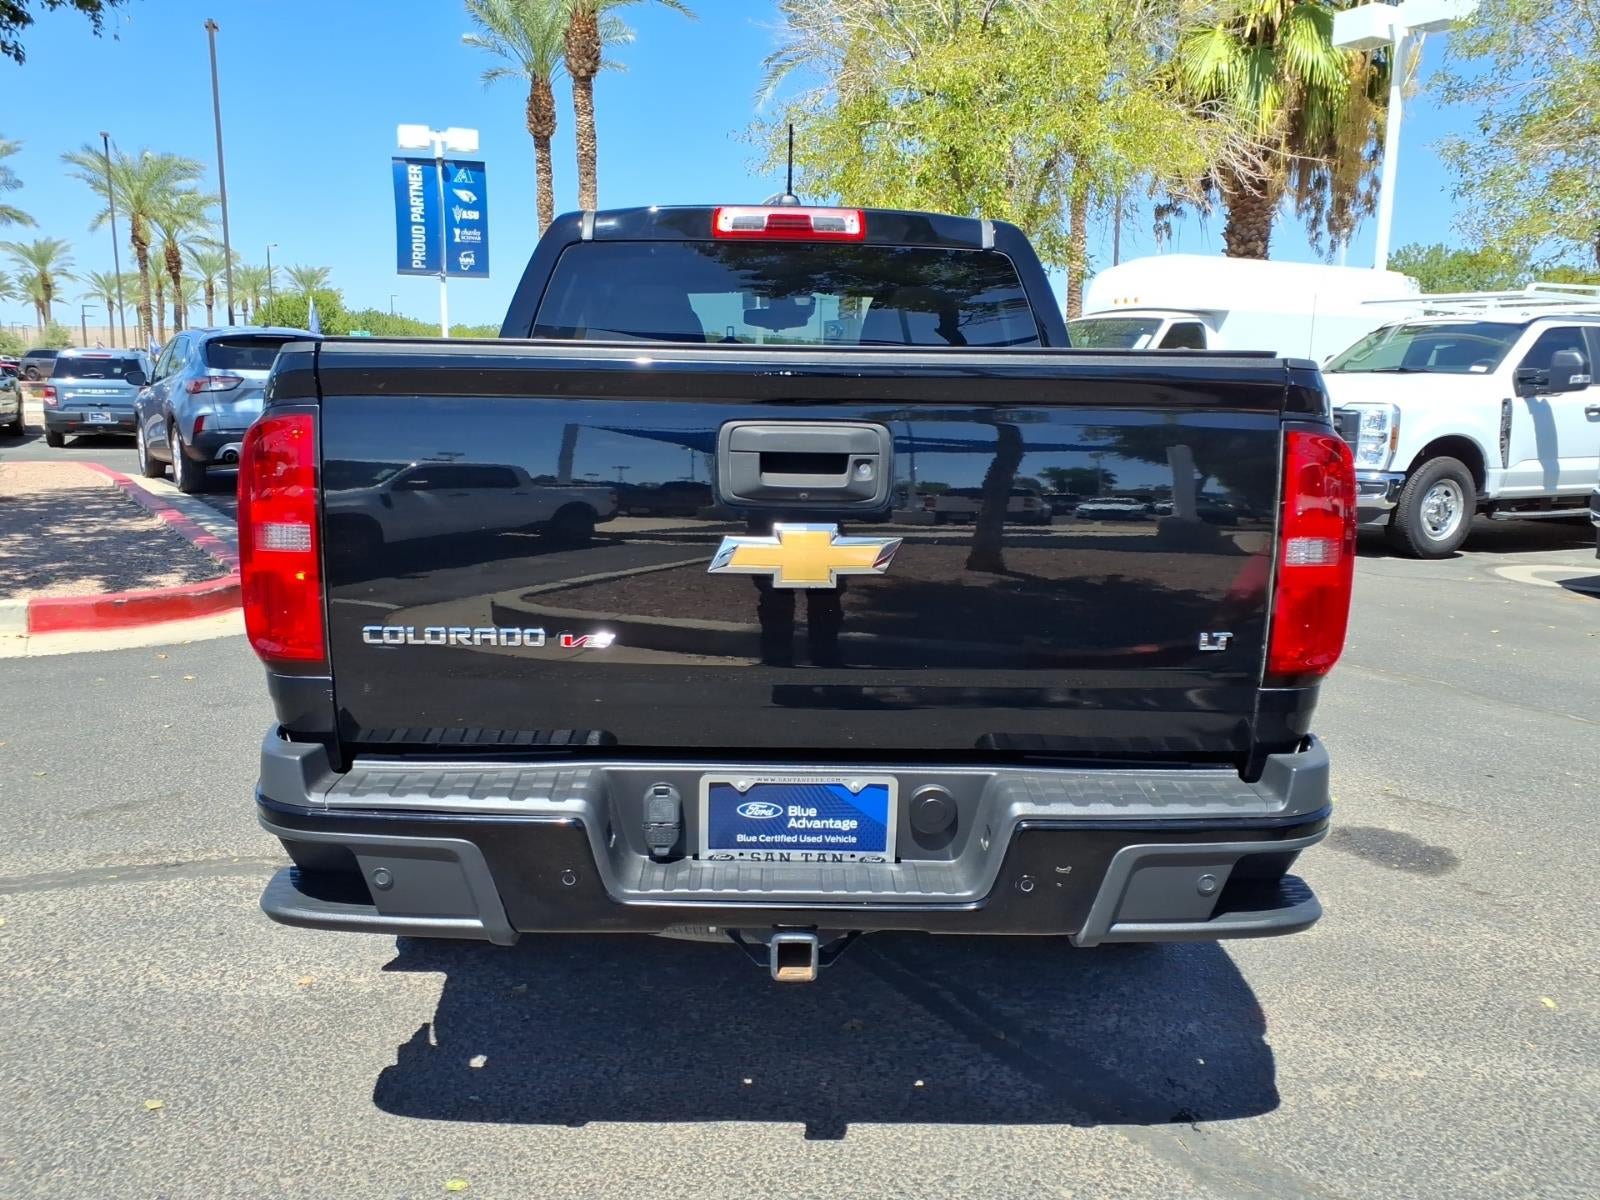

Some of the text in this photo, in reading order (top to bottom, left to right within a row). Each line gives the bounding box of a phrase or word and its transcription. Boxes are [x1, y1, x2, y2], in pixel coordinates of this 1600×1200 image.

[407, 164, 426, 269] PROUD PARTNER
[362, 625, 546, 647] COLORADO
[1199, 632, 1234, 651] LT
[745, 803, 774, 816] Ford
[787, 805, 817, 817] Blue
[787, 817, 858, 831] Advantage
[736, 834, 858, 843] Blue Certified Used Vehicle
[750, 851, 845, 863] SAN TAN
